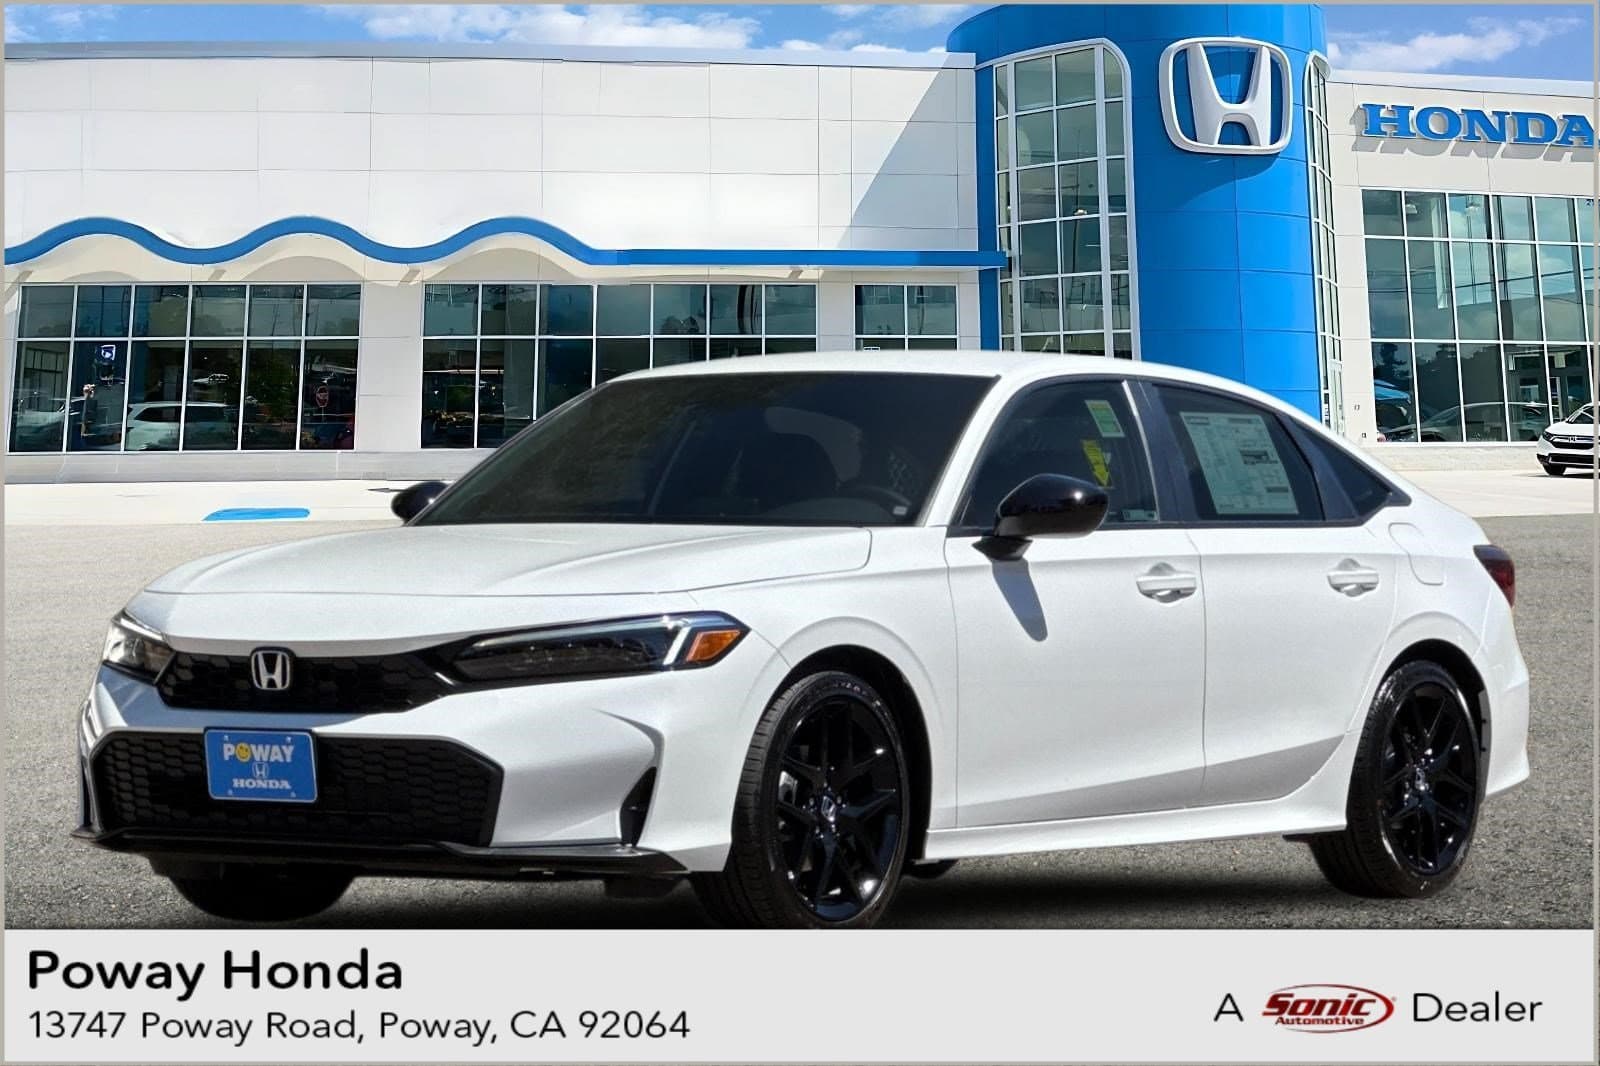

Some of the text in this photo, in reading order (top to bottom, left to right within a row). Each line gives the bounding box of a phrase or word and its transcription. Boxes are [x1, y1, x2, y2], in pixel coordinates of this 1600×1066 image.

[1361, 103, 1595, 149] HONDA
[223, 743, 295, 762] POWAY
[232, 778, 292, 790] HONDA
